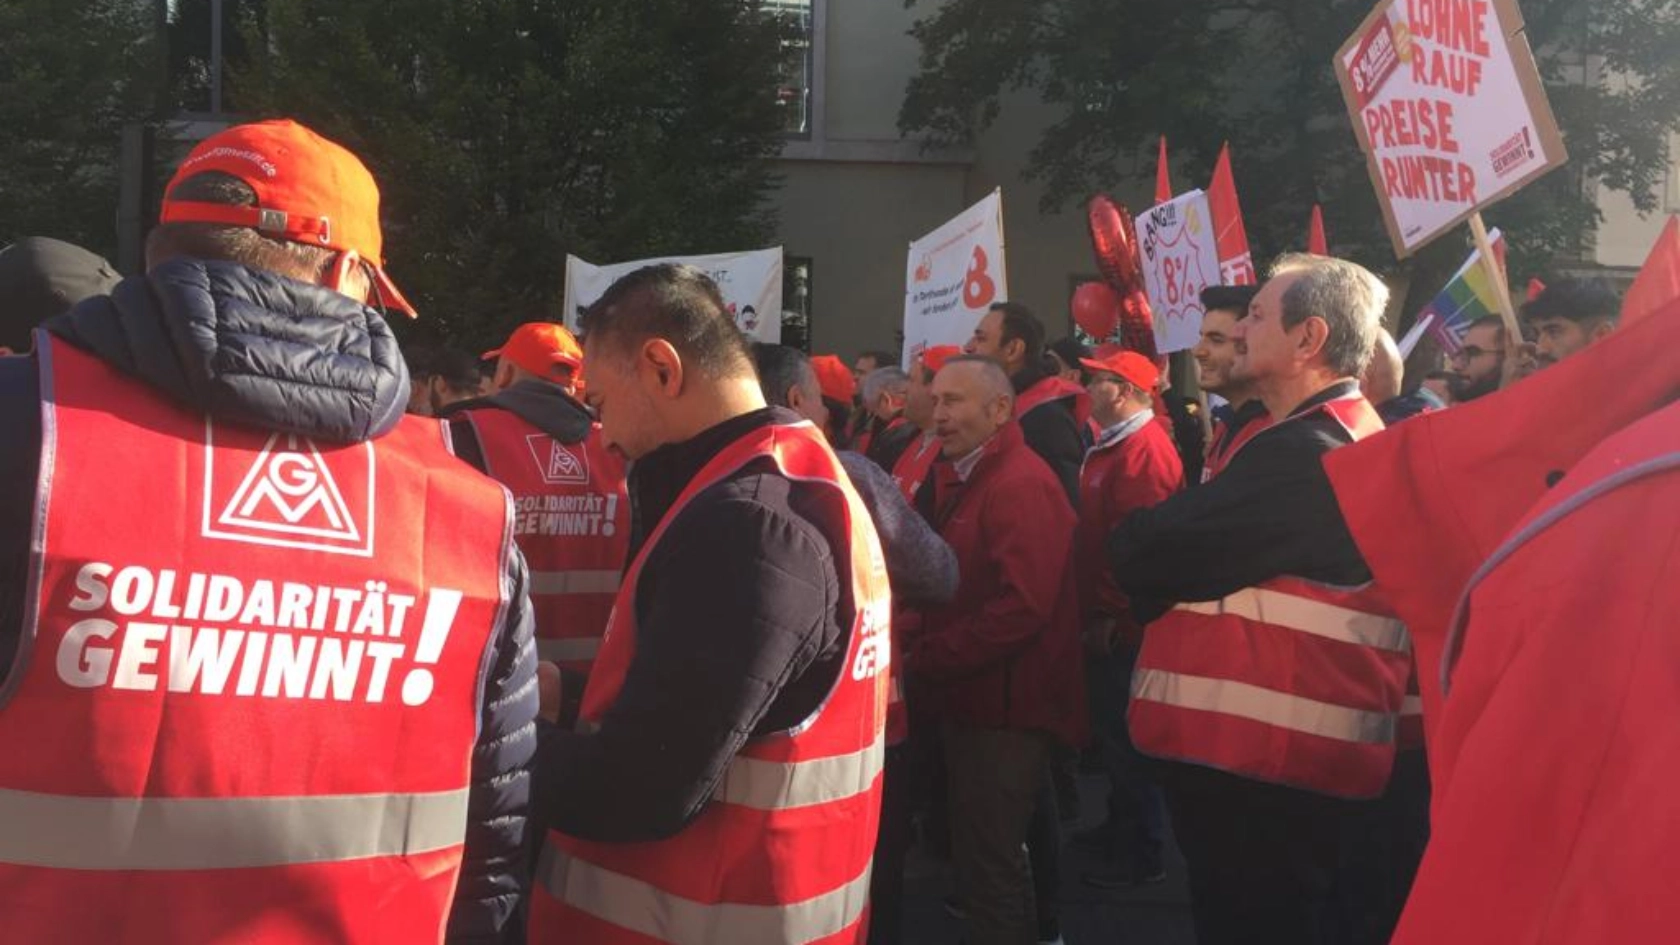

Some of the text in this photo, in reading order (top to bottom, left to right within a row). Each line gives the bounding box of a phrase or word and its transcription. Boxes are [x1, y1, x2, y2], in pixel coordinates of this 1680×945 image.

[1409, 43, 1482, 96] RAUF
[1366, 98, 1458, 153] PREISE
[1382, 156, 1477, 203] RUNTER
[963, 245, 996, 309] 8
[514, 492, 604, 513] SOLIDARITÄT
[69, 561, 416, 637] SOLIDARITÄT
